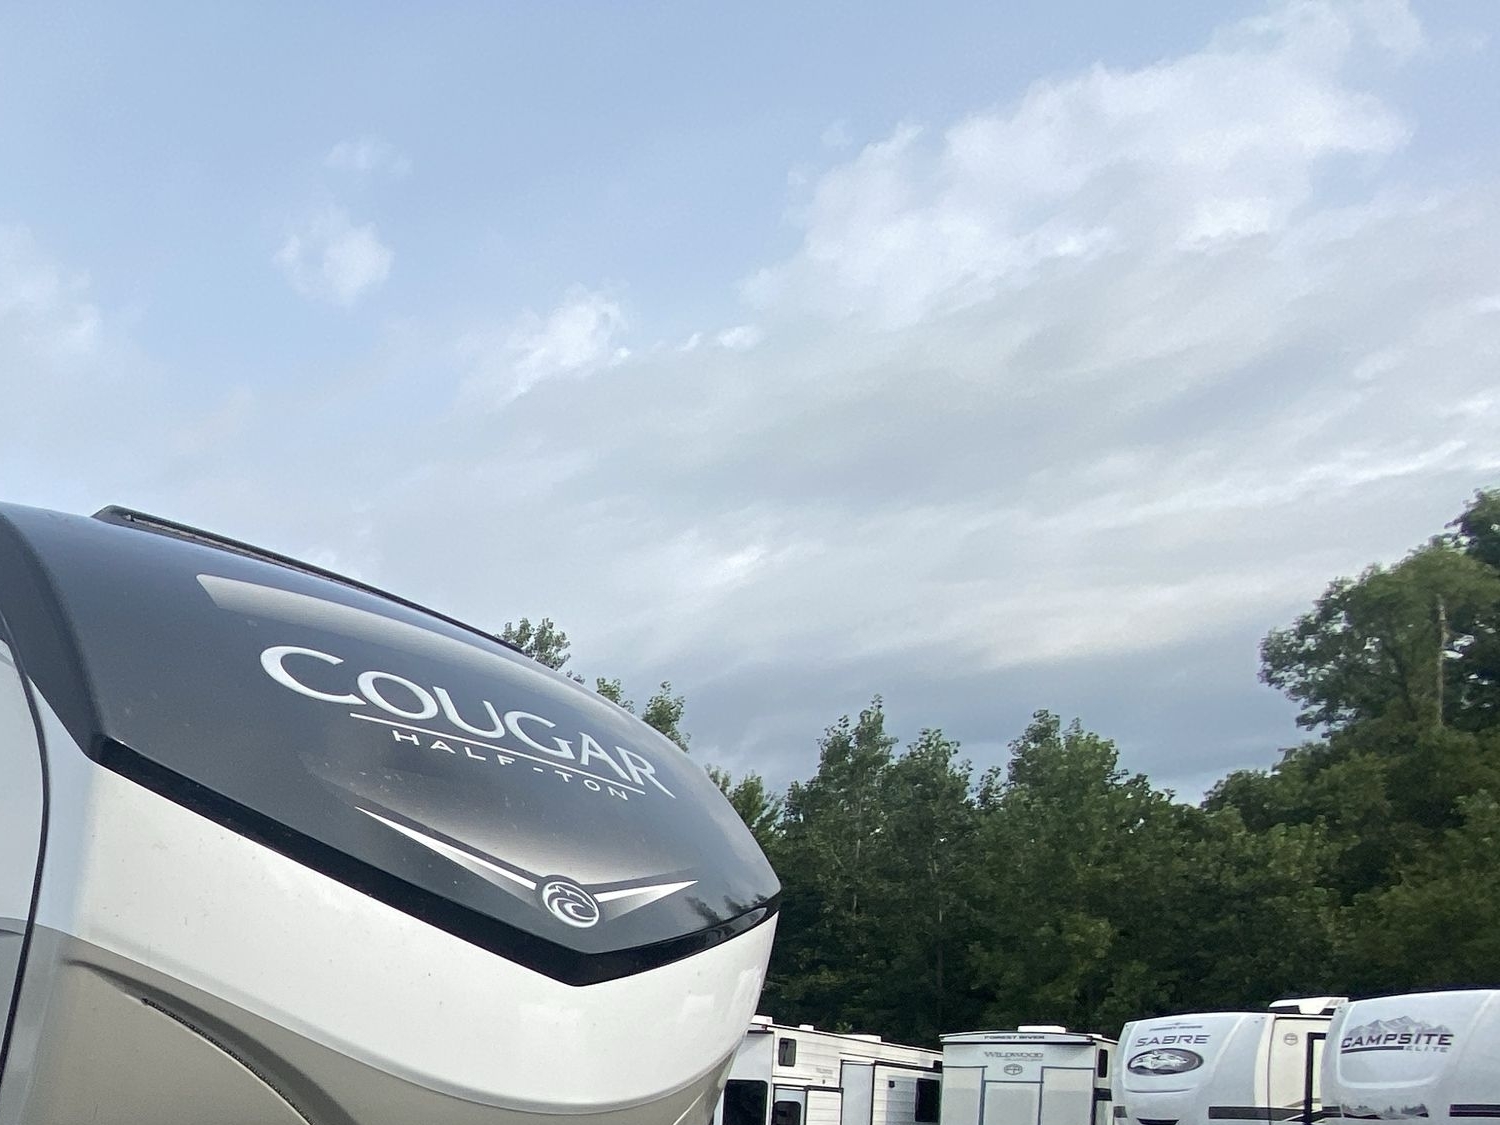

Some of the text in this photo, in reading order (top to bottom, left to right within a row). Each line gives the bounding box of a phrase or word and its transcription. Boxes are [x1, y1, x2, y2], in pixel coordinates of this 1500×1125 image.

[259, 645, 677, 799] COUGAR
[392, 729, 629, 801] HALF-TON
[1135, 1034, 1211, 1047] SABRE
[1341, 1033, 1454, 1049] CAMPSITE
[1404, 1045, 1450, 1053] ELITE
